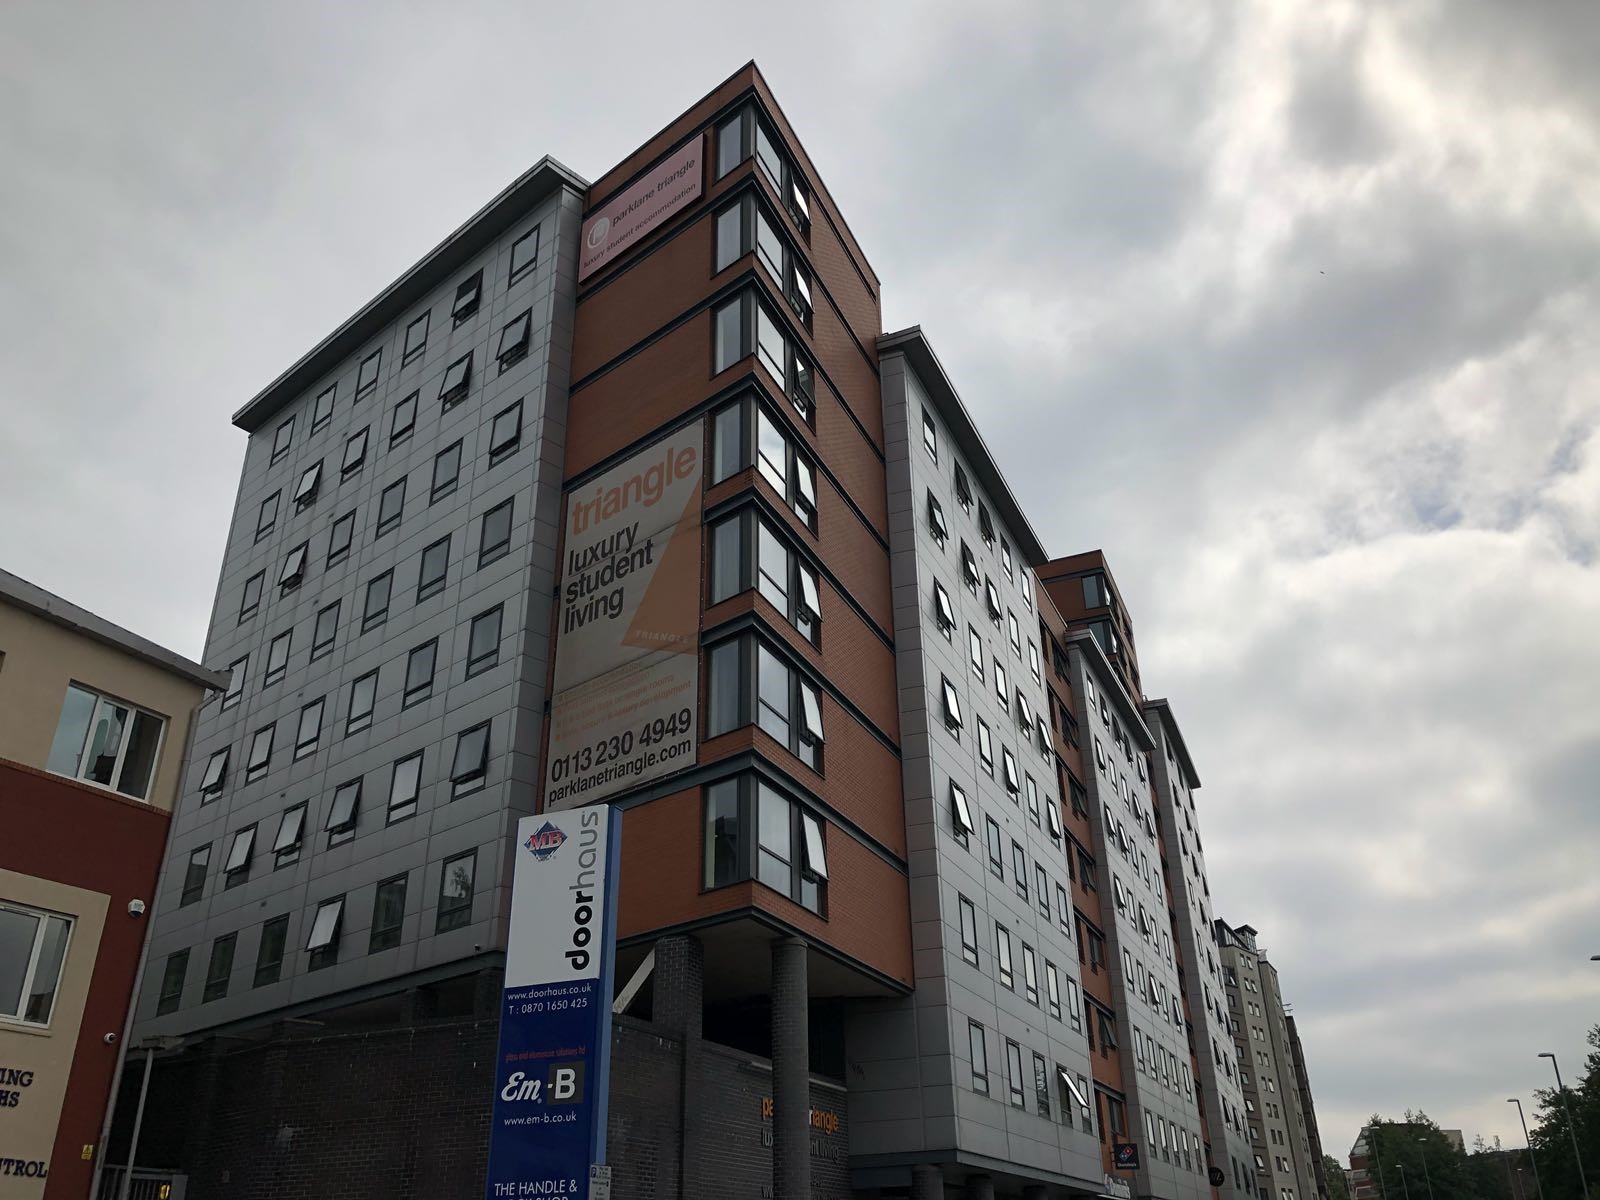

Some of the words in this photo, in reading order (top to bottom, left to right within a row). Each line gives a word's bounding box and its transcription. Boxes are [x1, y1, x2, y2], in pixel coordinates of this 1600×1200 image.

[612, 188, 655, 227] parklane
[657, 158, 696, 192] triangle
[583, 250, 605, 269] luxury
[606, 227, 634, 252] student
[634, 183, 696, 231] accommodation
[571, 446, 697, 536] triangle
[566, 537, 653, 604] student
[568, 520, 640, 576] luxury
[564, 586, 625, 635] living
[549, 739, 692, 807] parklanetriangle.com
[551, 746, 592, 783] 0113
[595, 730, 634, 766] 230
[639, 707, 692, 747] 4949
[565, 810, 599, 971] doorhaus
[507, 982, 592, 1000] www.doorhaus.co.uk
[521, 1003, 544, 1014] 0870
[546, 999, 568, 1011] 1650
[570, 997, 588, 1009] 425
[504, 1110, 577, 1126] www.em-b.co.uk
[809, 1104, 840, 1135] riangle
[494, 1183, 515, 1197] THE
[518, 1180, 566, 1195] HANDLE
[569, 1180, 578, 1193] &
